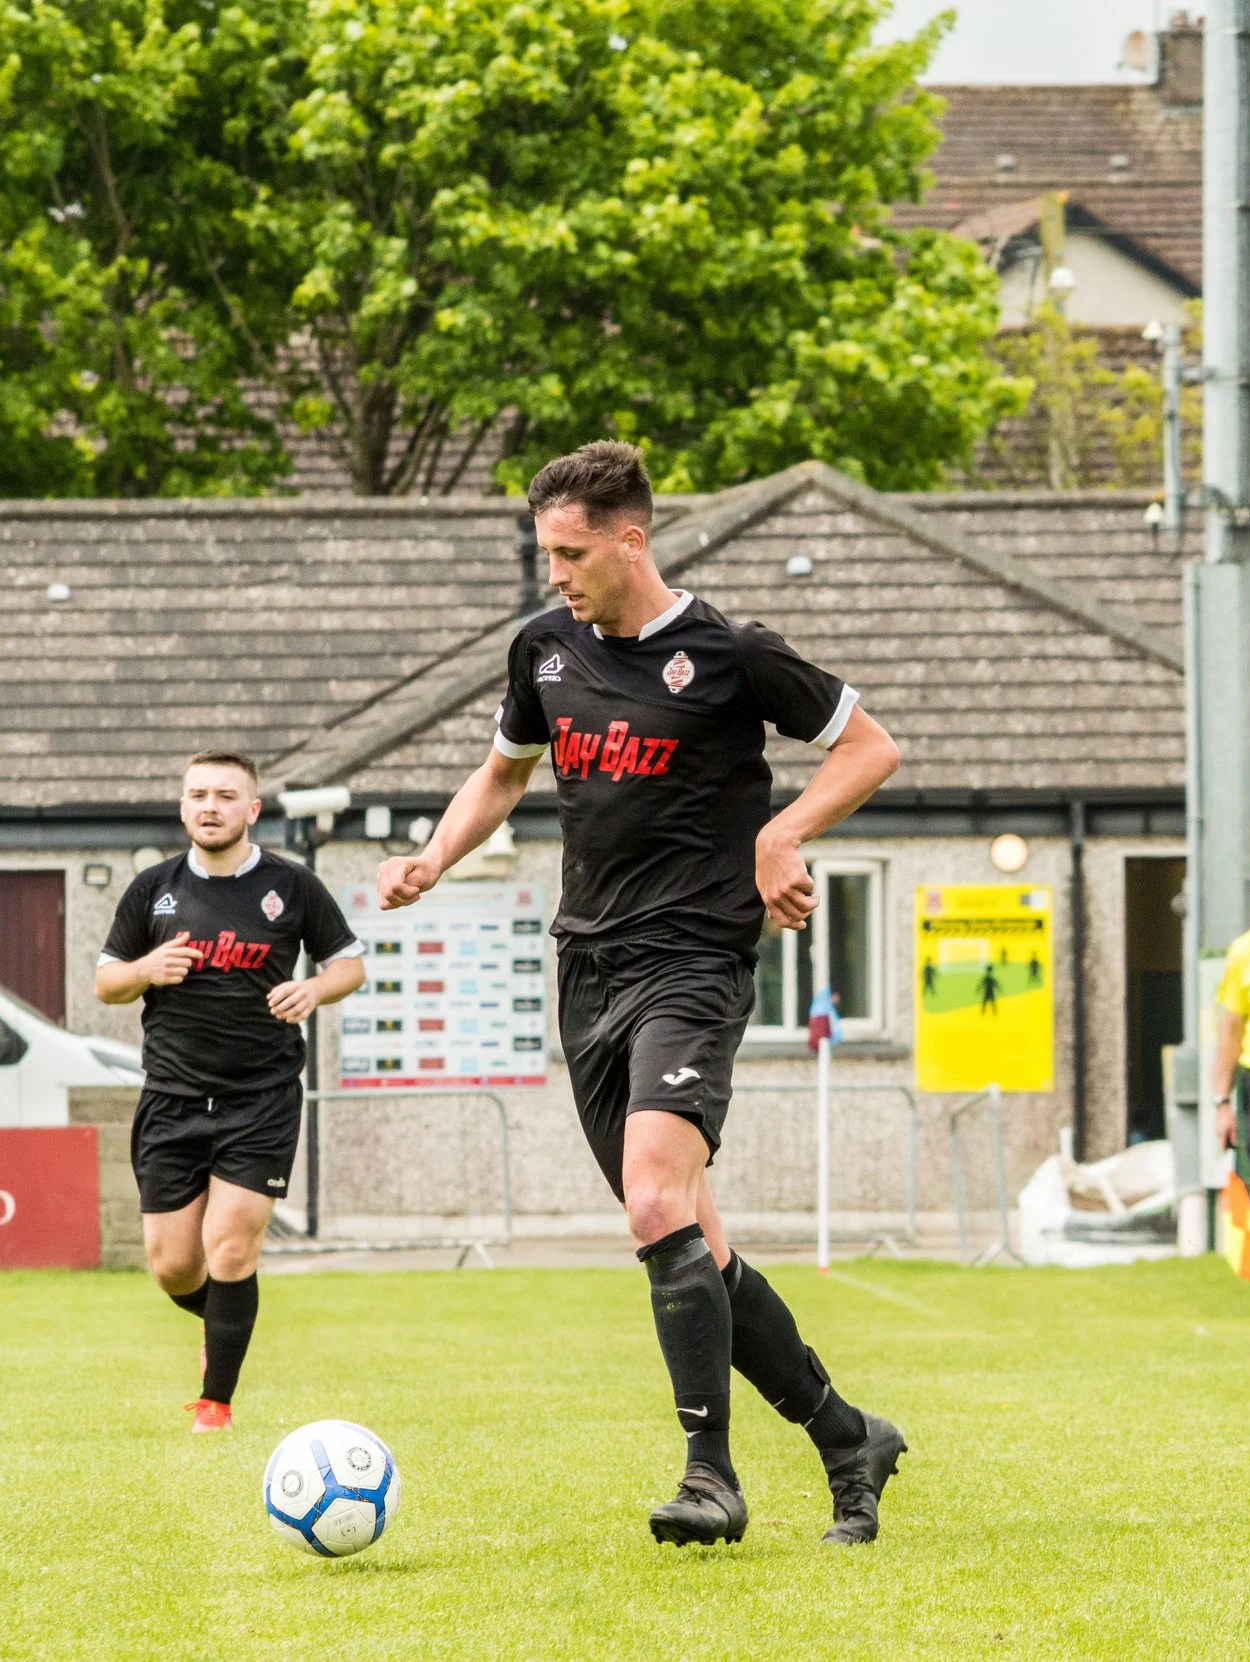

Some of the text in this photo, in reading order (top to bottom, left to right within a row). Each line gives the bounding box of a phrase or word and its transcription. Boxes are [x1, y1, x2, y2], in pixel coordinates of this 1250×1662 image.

[554, 717, 678, 781] JAY BAZZ
[211, 930, 271, 974] BAZZ
